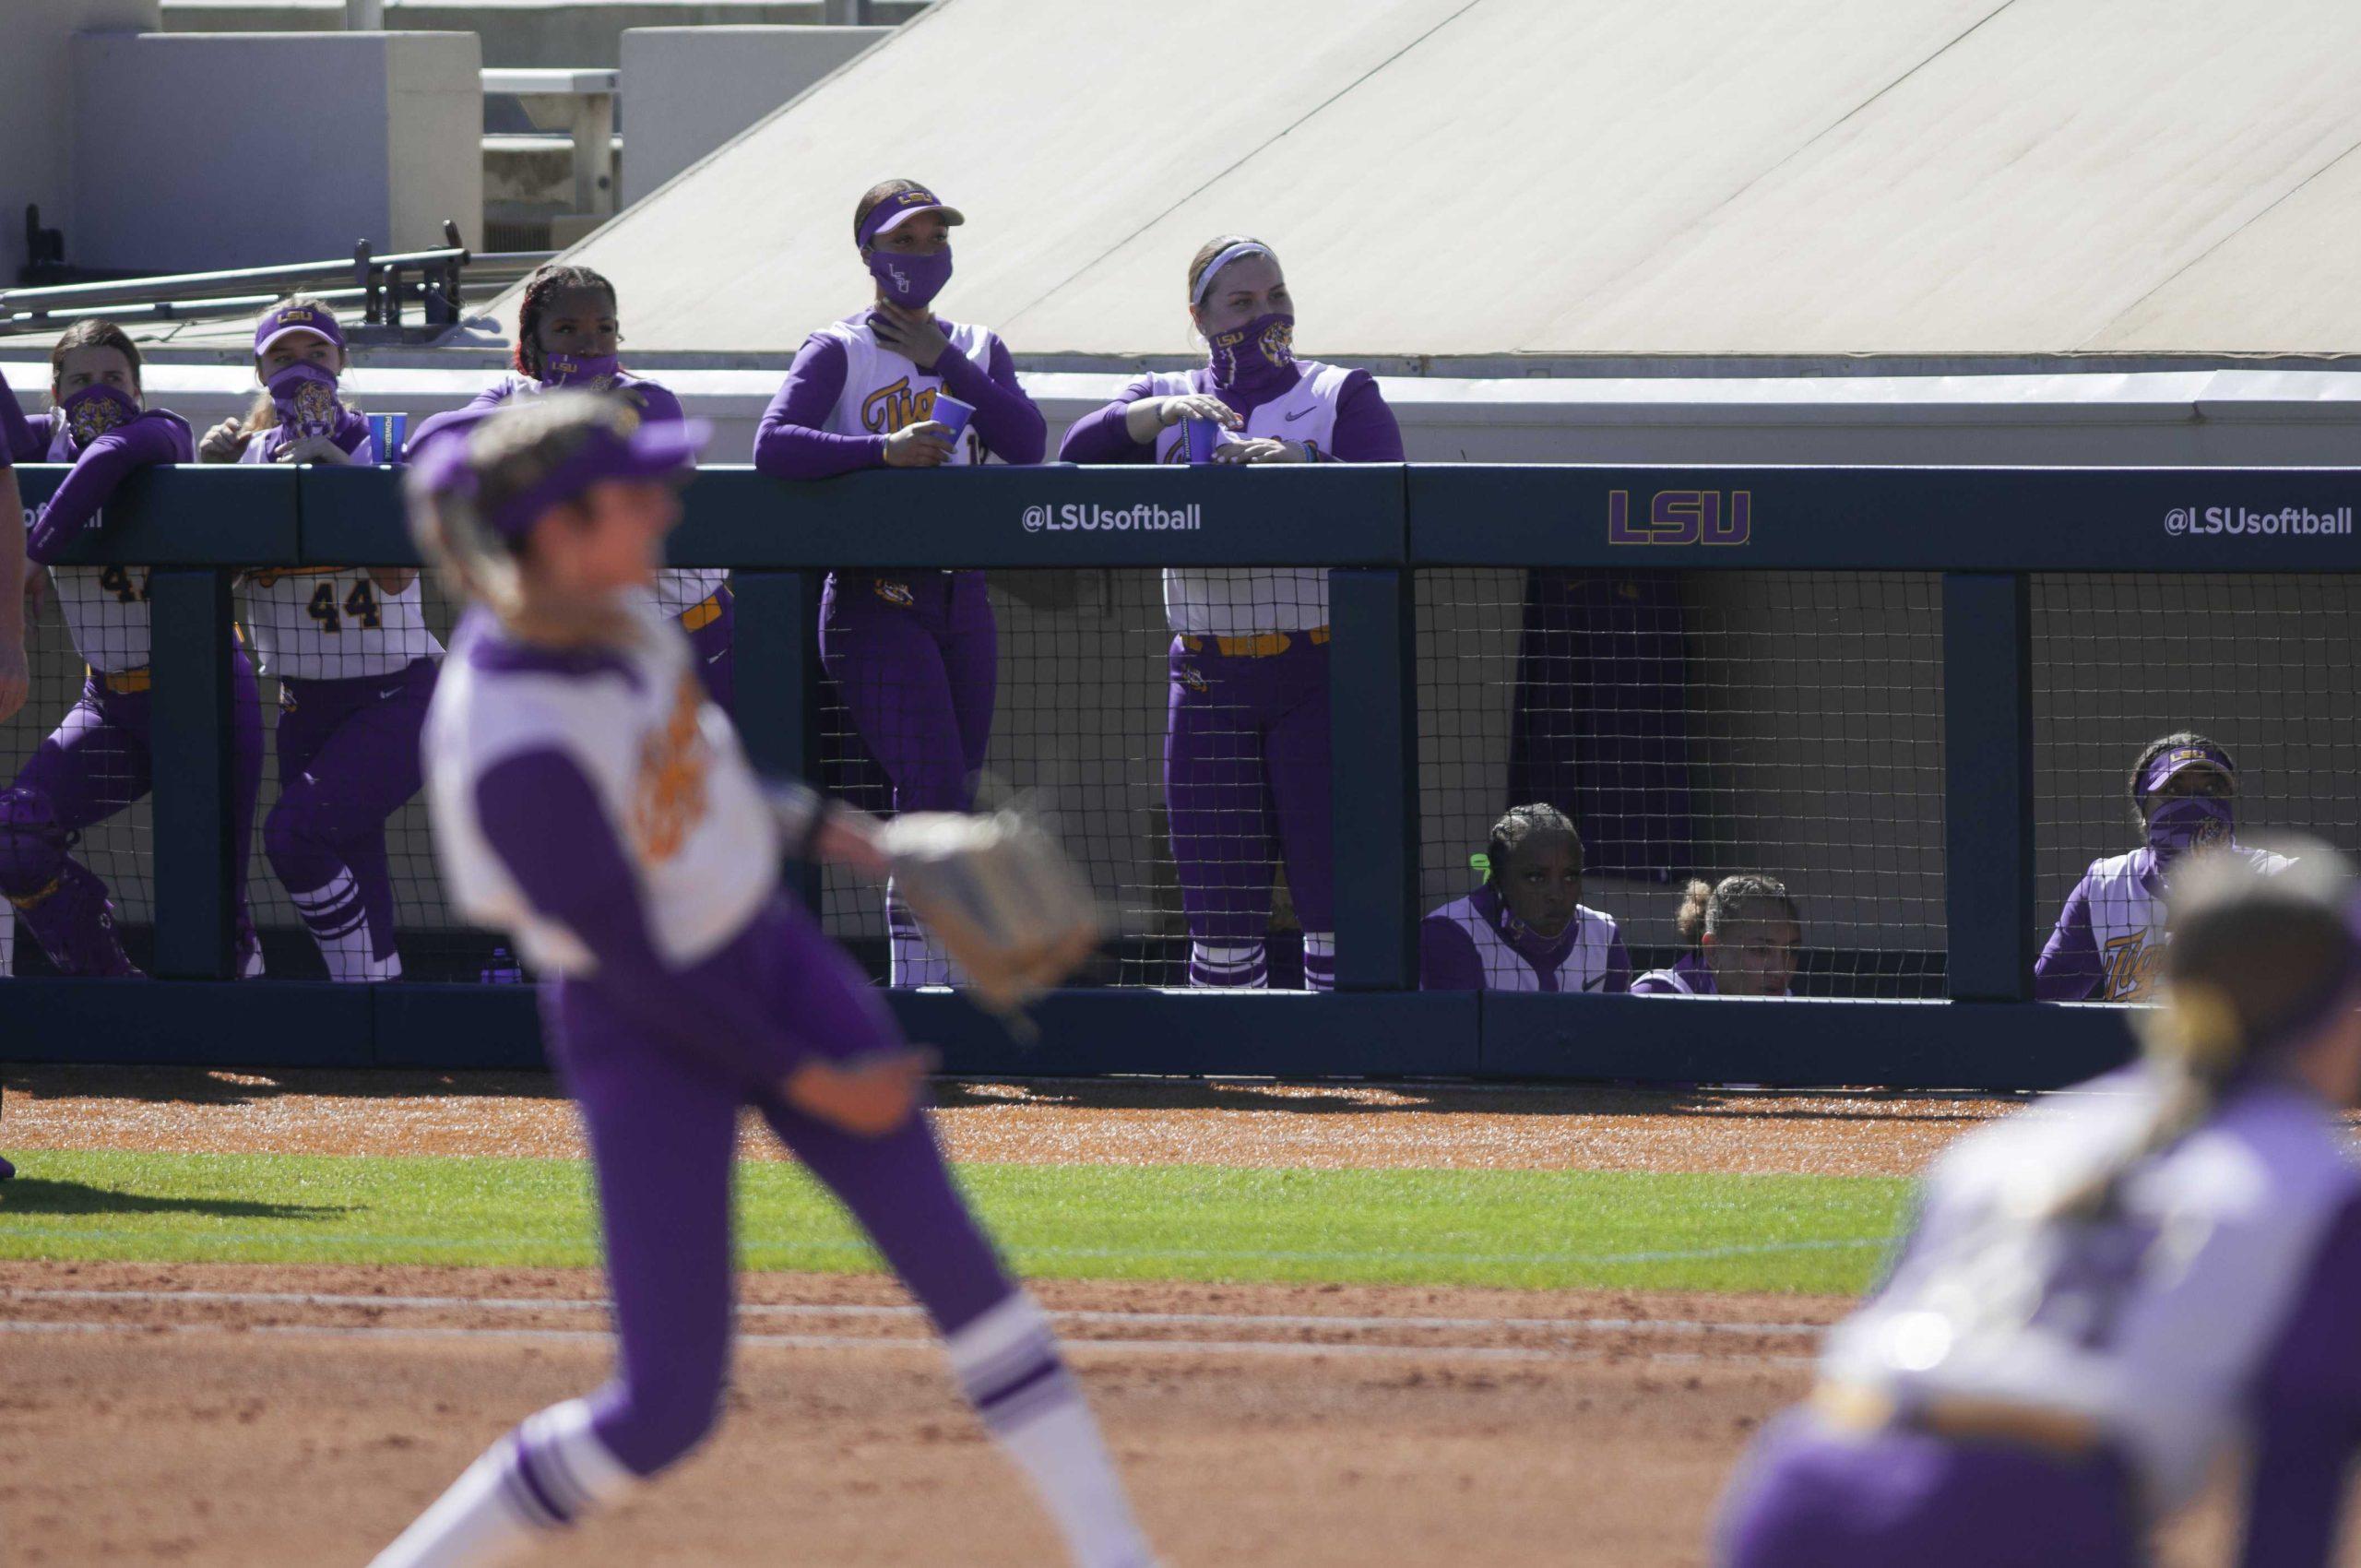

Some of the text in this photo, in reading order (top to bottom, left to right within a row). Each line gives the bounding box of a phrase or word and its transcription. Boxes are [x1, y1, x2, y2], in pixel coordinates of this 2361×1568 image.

[278, 310, 314, 324] LSU
[1216, 331, 1244, 348] LSU
[552, 361, 577, 373] LSU
[1022, 504, 1200, 533] @LSUsoftball
[1608, 490, 1750, 545] LSU
[2164, 506, 2352, 536] @LSUsoftball
[306, 578, 382, 634] 44
[2170, 749, 2206, 762] LSU
